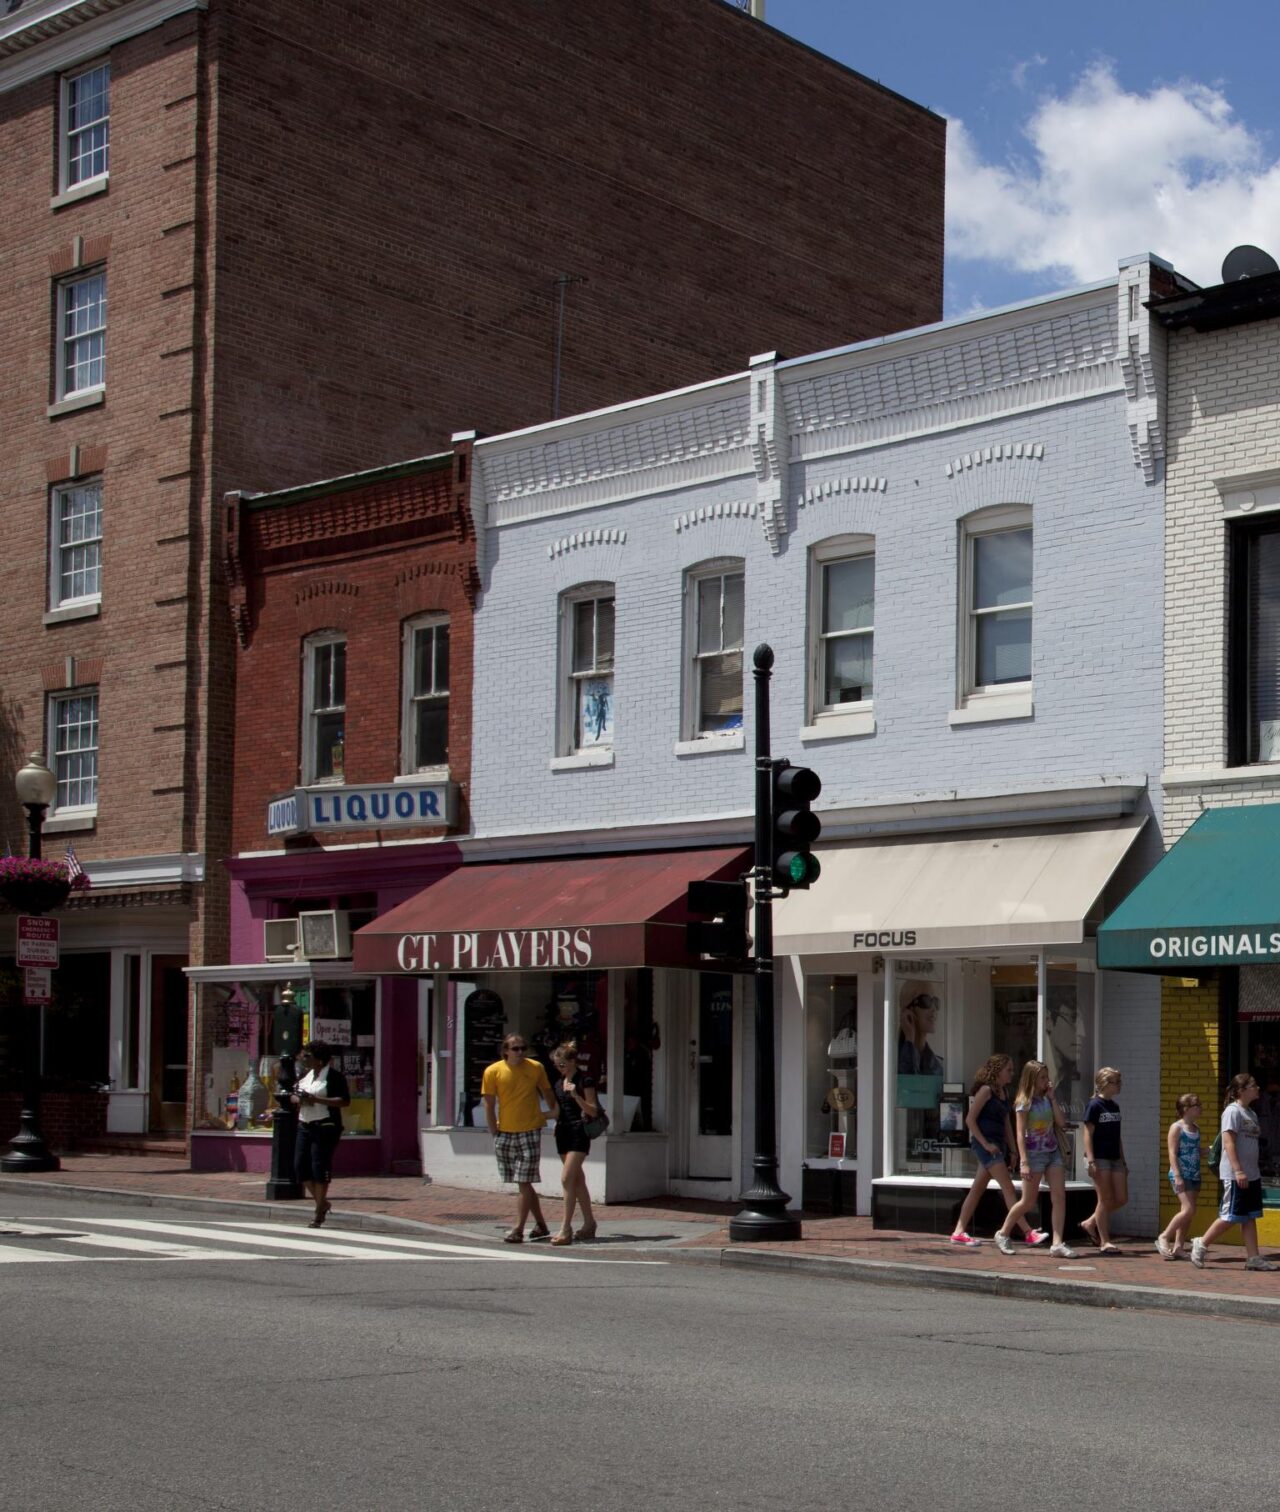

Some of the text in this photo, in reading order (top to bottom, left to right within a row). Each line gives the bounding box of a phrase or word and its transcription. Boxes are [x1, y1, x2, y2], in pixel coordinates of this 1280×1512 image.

[315, 791, 440, 823] LIQUOR
[27, 919, 51, 927] SNOW
[397, 928, 592, 971] GT. PLAYERS
[853, 931, 916, 948] FOCUS
